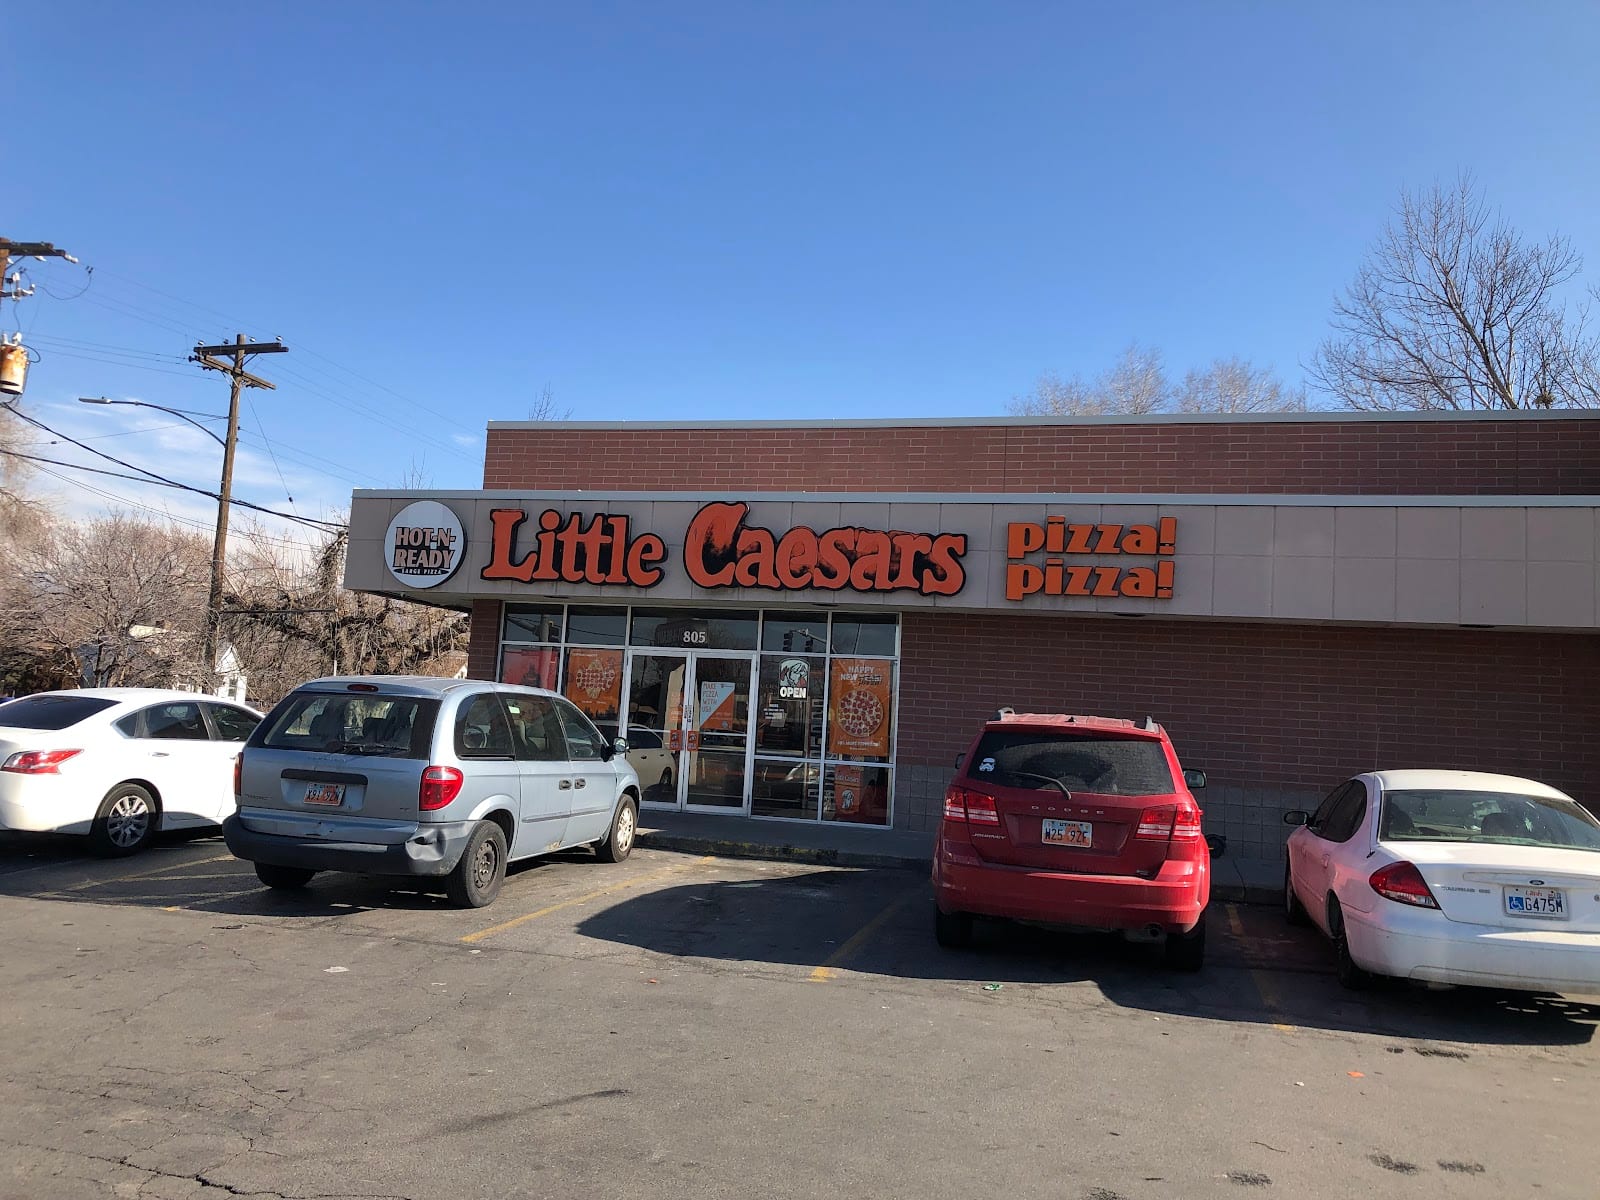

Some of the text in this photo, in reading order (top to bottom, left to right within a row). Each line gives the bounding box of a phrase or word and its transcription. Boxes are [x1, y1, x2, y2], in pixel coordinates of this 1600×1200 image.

[396, 527, 456, 547] HOT-N-
[1007, 516, 1177, 559] pizza!
[393, 548, 455, 569] READY
[481, 501, 968, 597] Little Caesars
[1006, 558, 1175, 600] pizza!
[683, 631, 706, 643] 805
[780, 686, 807, 699] OPEN
